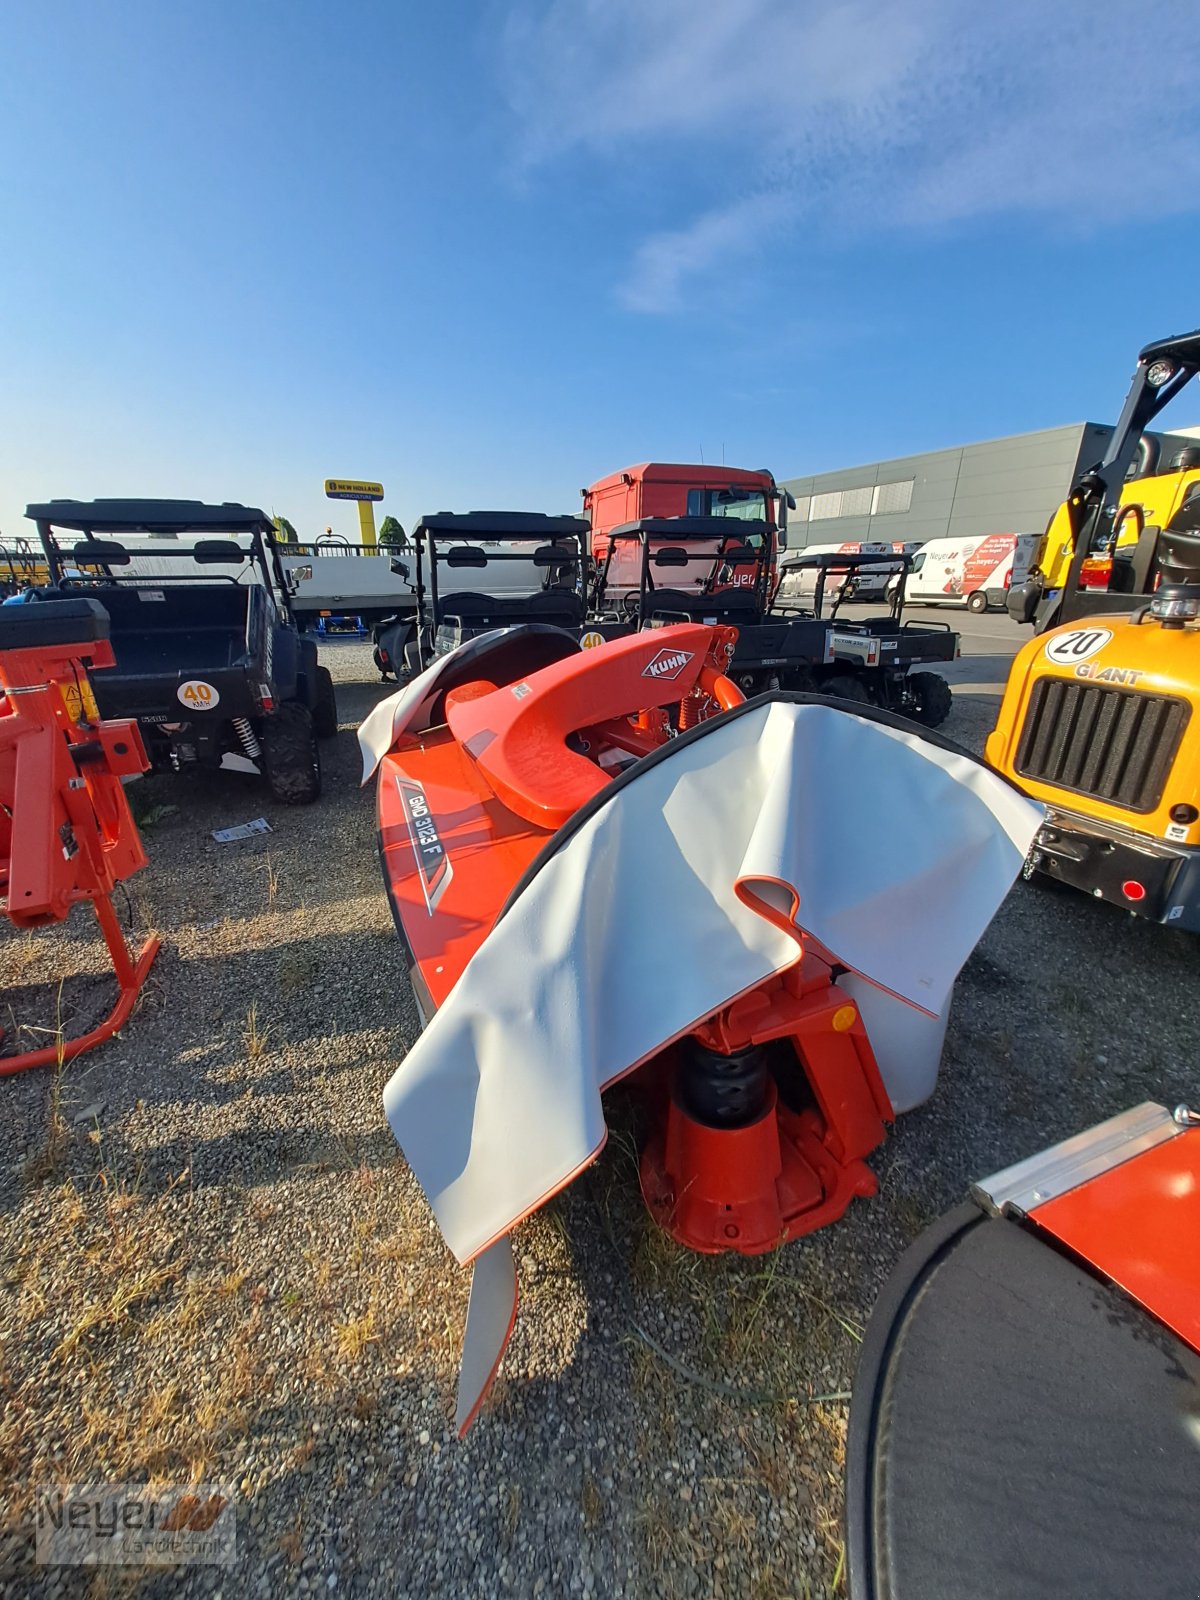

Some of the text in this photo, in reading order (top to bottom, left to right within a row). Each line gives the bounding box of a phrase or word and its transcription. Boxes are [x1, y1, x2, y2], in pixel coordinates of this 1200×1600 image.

[353, 485, 380, 493] HOLLAND
[929, 552, 948, 560] Neyer
[583, 634, 602, 650] 40
[1053, 632, 1104, 655] 20
[649, 653, 688, 676] KUHN
[184, 684, 212, 702] 40
[409, 795, 442, 854] GMD 3123 F
